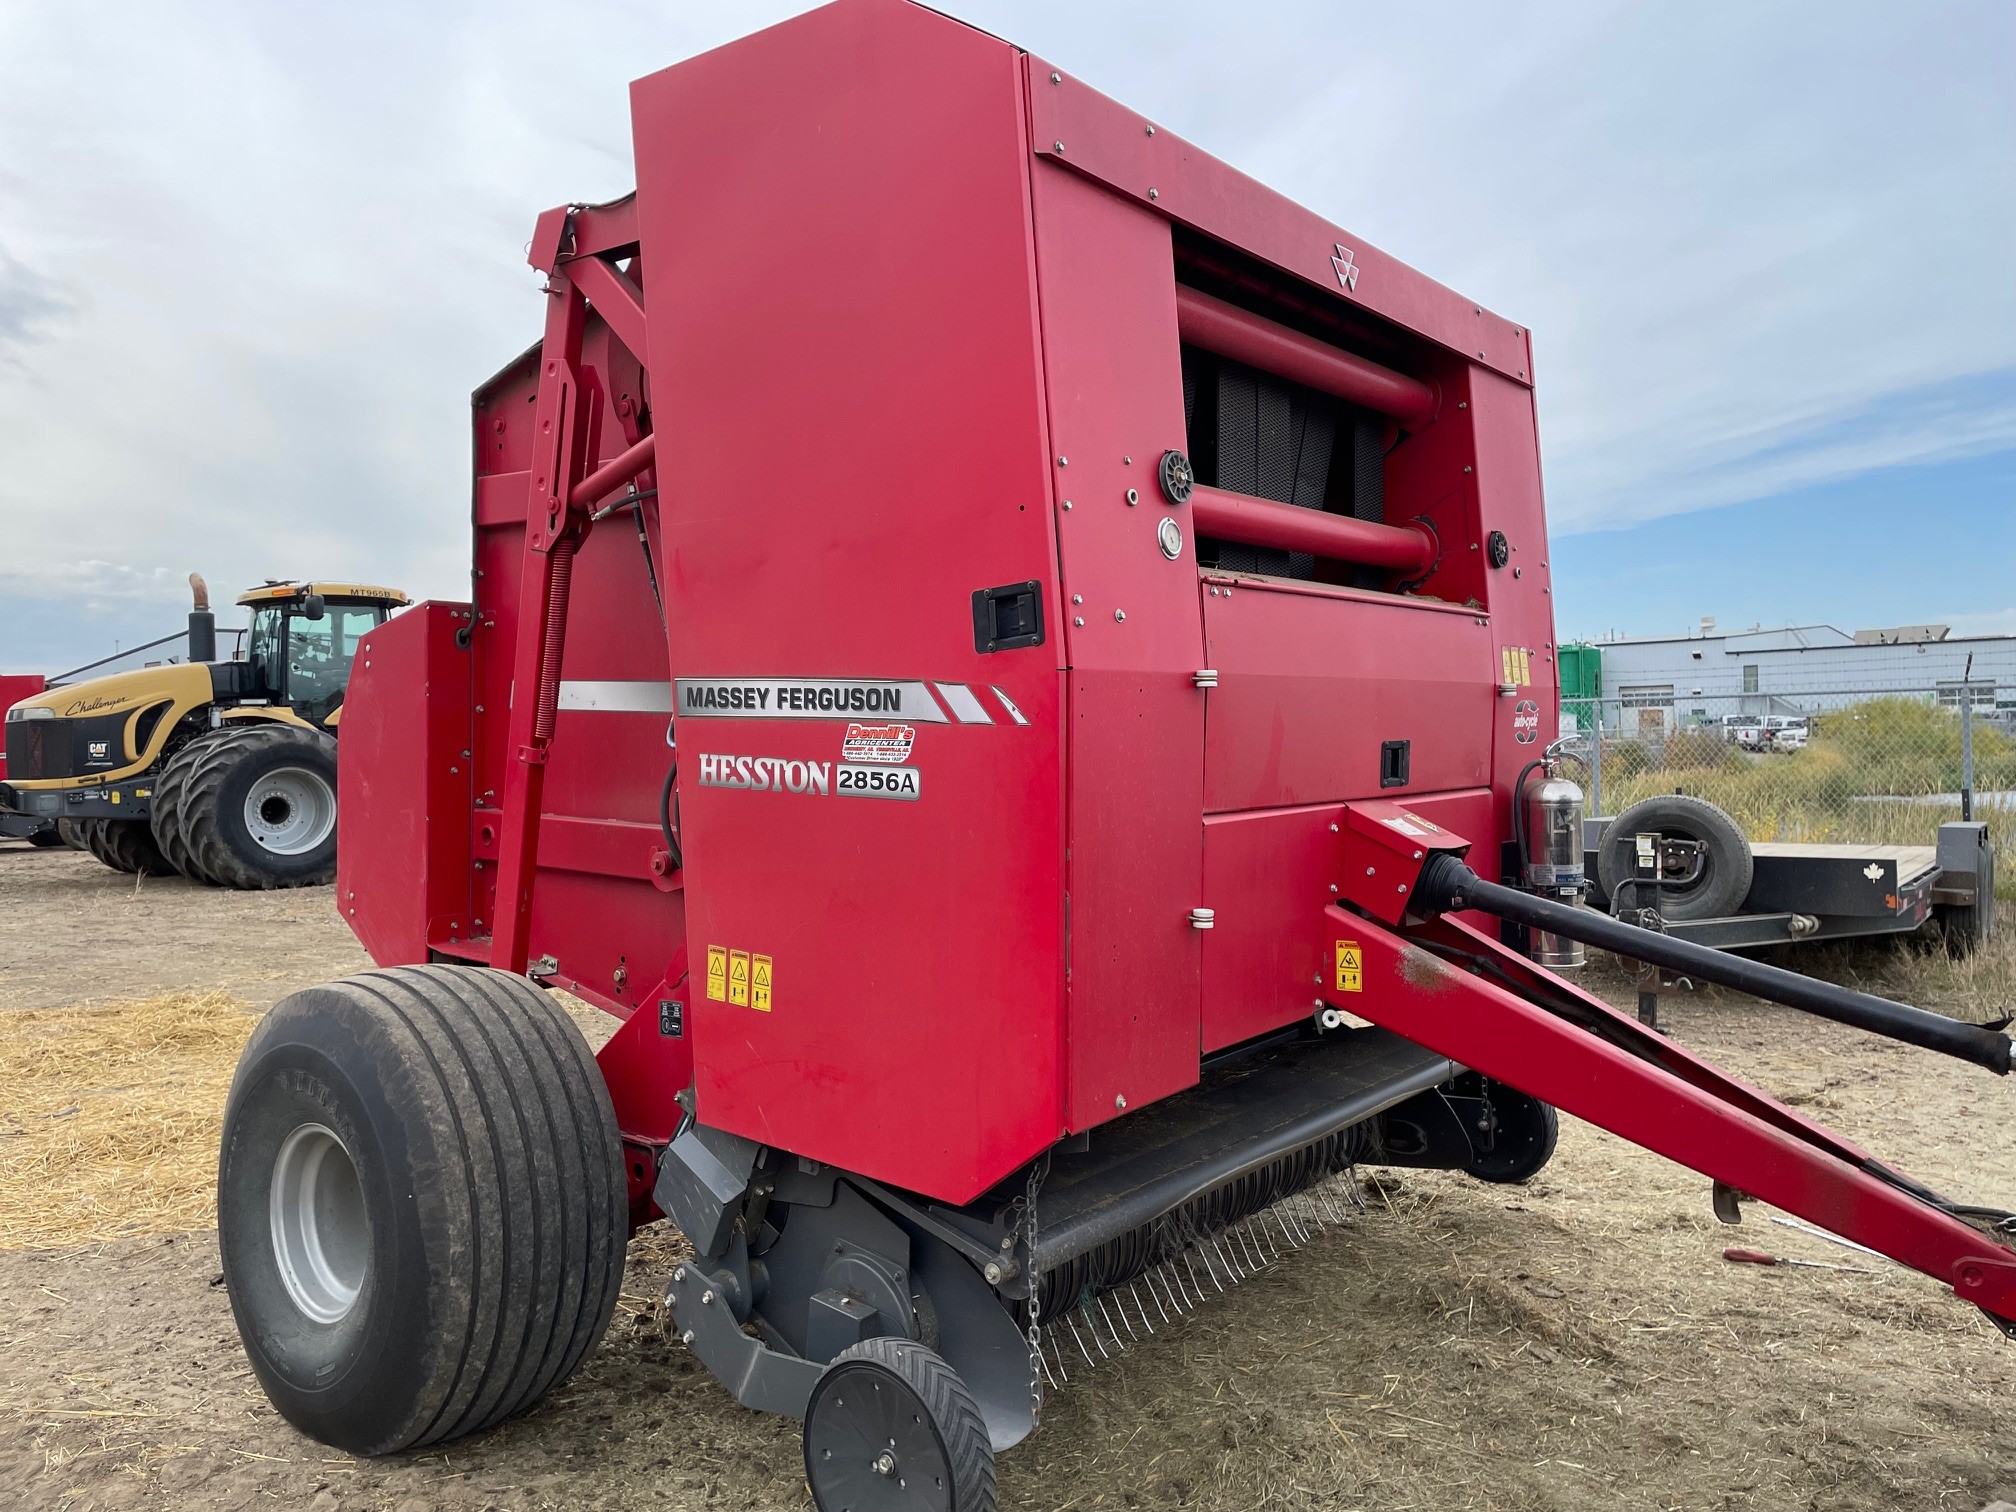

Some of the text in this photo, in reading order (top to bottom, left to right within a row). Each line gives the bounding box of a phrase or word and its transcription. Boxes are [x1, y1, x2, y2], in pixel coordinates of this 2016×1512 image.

[350, 588, 391, 598] MT965B
[64, 696, 136, 716] Challenger
[686, 687, 901, 712] MASSEY FERGUSON
[847, 726, 914, 740] Dennill's
[89, 743, 107, 754] CAT
[699, 753, 916, 795] HESSTON 2856A
